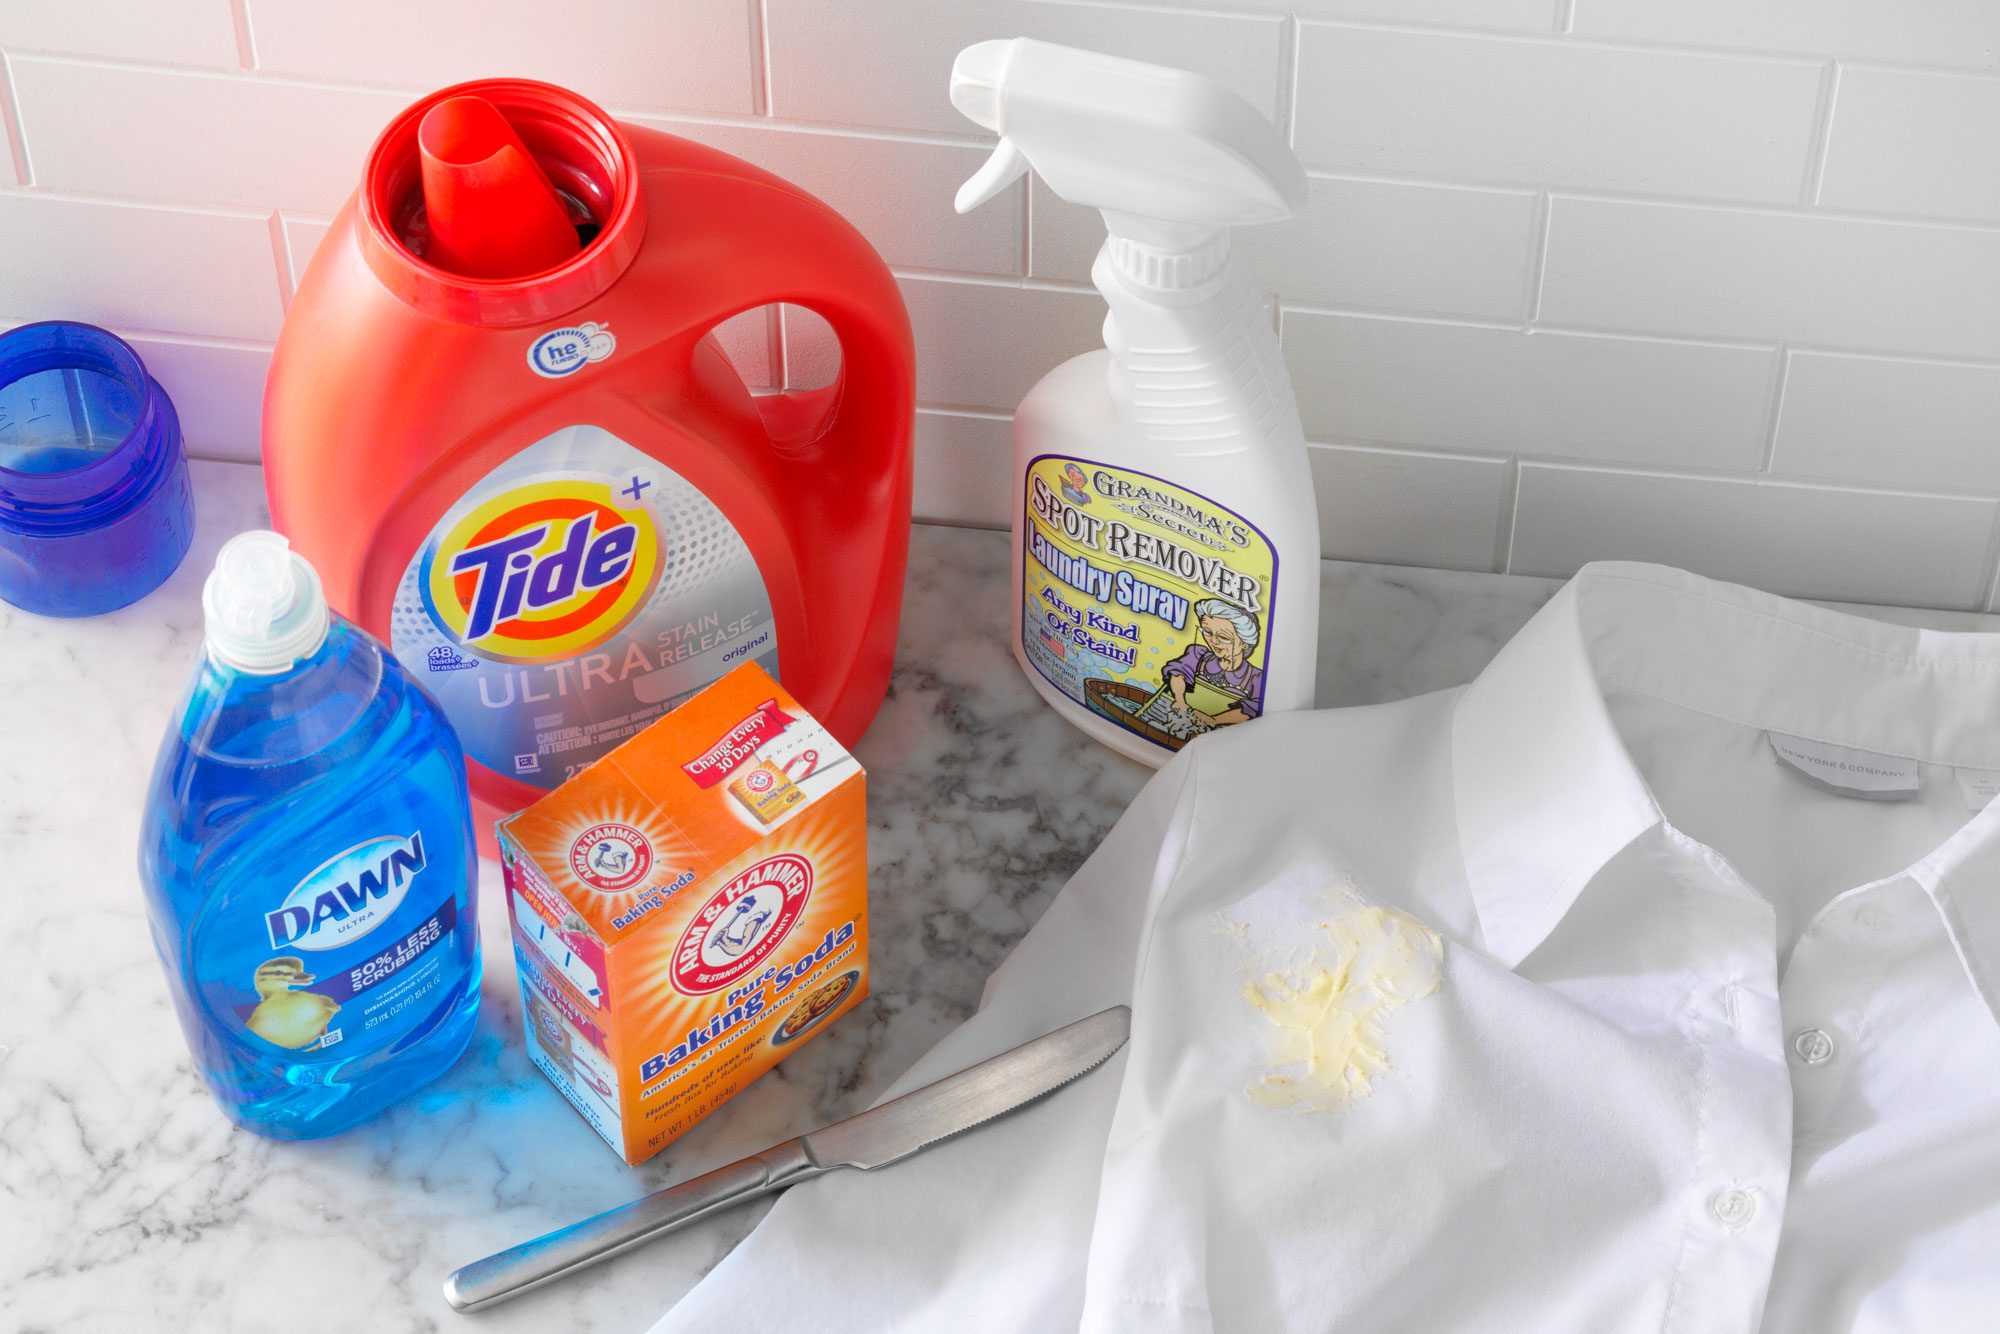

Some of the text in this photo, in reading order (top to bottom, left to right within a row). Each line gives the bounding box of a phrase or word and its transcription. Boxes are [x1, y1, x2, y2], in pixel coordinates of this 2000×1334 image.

[547, 343, 577, 359] he
[1092, 470, 1250, 548] GRANDMA'S
[1032, 473, 1260, 612] SPOT REMOVER
[448, 511, 638, 645] Tide
[1029, 515, 1190, 630] Laundry Spray
[657, 611, 719, 648] STAIN
[660, 614, 753, 667] RELEASE
[1041, 586, 1083, 623] Any
[1087, 608, 1139, 642] Kind
[1046, 611, 1073, 637] Of
[1073, 627, 1137, 667] Stain!
[428, 647, 453, 658] 48
[722, 632, 768, 662] original
[479, 643, 653, 708] ULTRA
[536, 727, 583, 744] CAUTION:
[689, 715, 766, 775] Change Every
[716, 734, 761, 774] 30 Days
[1780, 747, 1805, 760] NEW
[1806, 755, 1837, 768] YORK
[1848, 764, 1905, 777] COMPANY
[575, 827, 643, 879] ARM & HAMMER
[265, 830, 427, 950] DAWN
[524, 889, 543, 913] OPEN
[611, 871, 696, 931] Baking Soda
[637, 885, 658, 901] Pure
[338, 911, 375, 934] ULTRA
[679, 861, 804, 975] ARM & HAMMER
[351, 952, 392, 983] 50%
[396, 917, 439, 957] LESS
[696, 912, 792, 983] THE STANDARD OF PURITY
[364, 981, 416, 1015] DISHWASHING
[547, 988, 574, 1021] Days
[555, 987, 588, 1025] Every
[641, 921, 855, 1084] Baking Soda
[727, 966, 777, 1006] Pure
[365, 1018, 378, 1030] 573
[642, 942, 856, 1099] America's #1 Trusted Baking Soda Brand
[645, 1035, 767, 1119] Hundreds of uses like:
[653, 1053, 755, 1122] Fresh Box for Baking
[648, 1130, 667, 1147] NET
[668, 1120, 685, 1136] WT.
